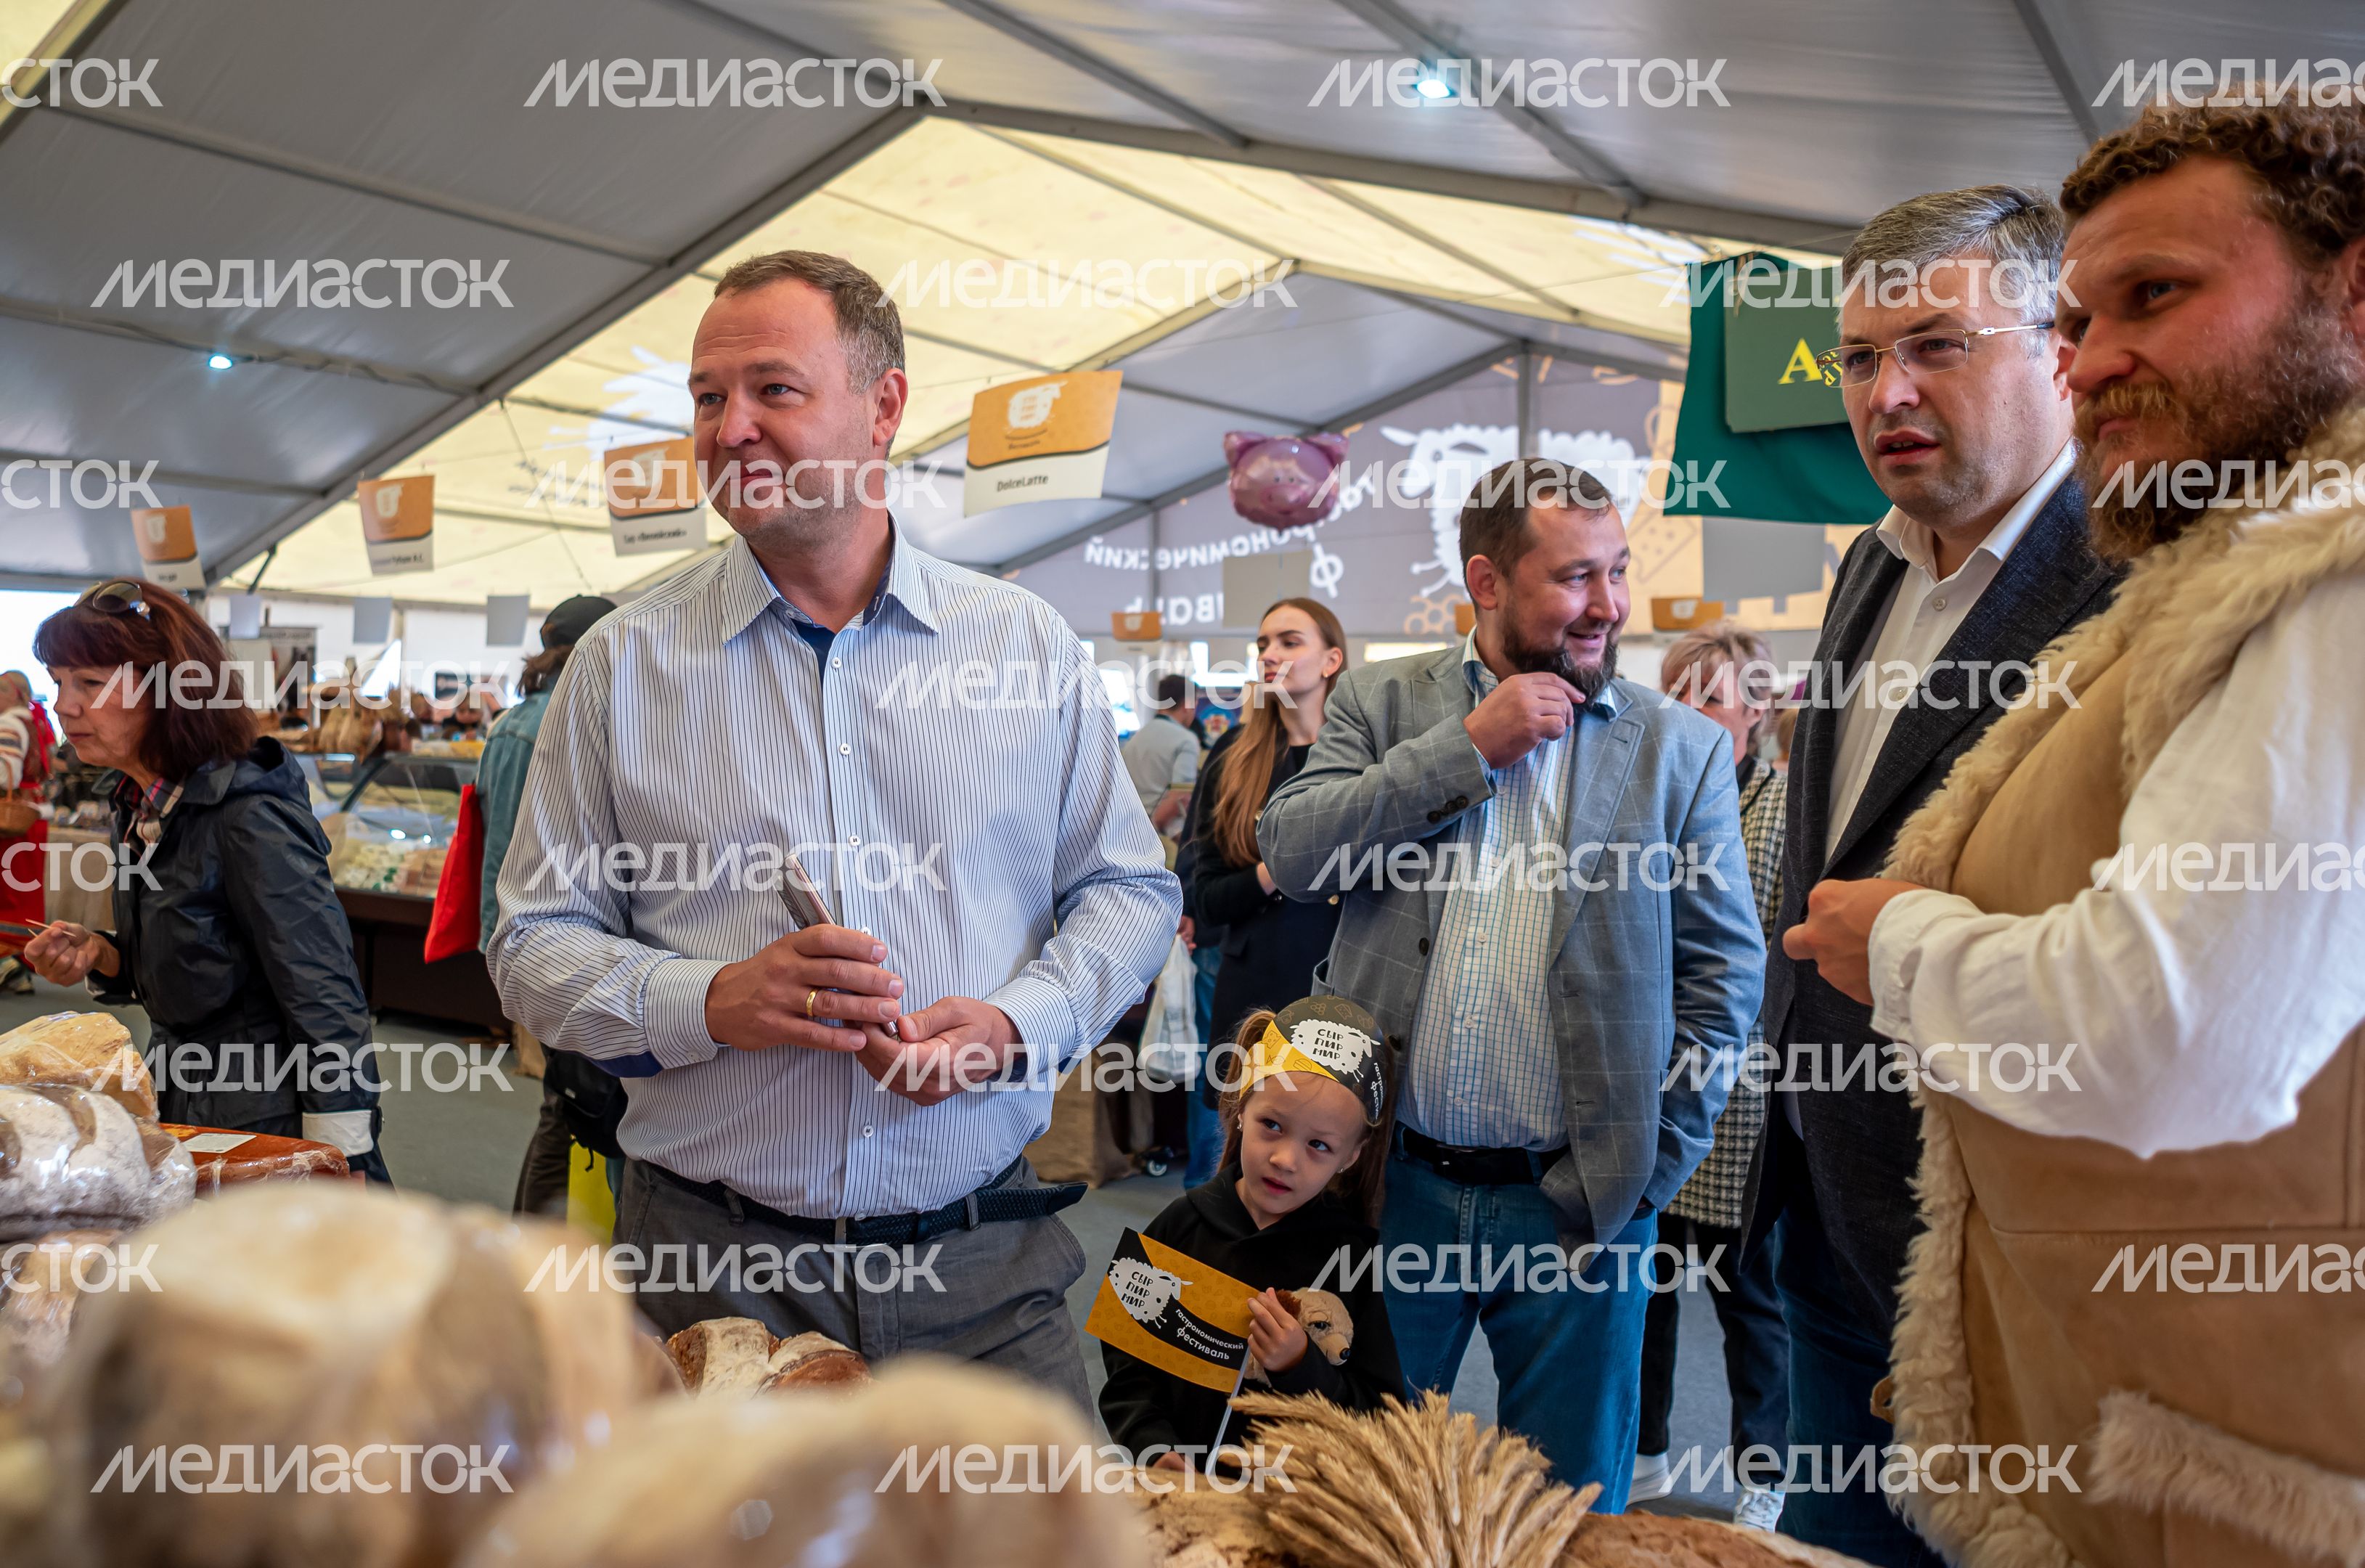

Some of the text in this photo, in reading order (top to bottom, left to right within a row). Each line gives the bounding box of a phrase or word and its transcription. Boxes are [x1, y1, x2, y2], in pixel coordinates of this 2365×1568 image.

[1317, 1028, 1344, 1041] СЫР
[1314, 1037, 1344, 1051] ПИР
[1312, 1048, 1341, 1060] МИР
[1131, 1270, 1154, 1286] СЫР
[1125, 1281, 1151, 1298] ПИР
[1121, 1293, 1145, 1309] МИР
[1175, 1308, 1245, 1350] гастрономический
[1176, 1327, 1230, 1360] фестиваль
